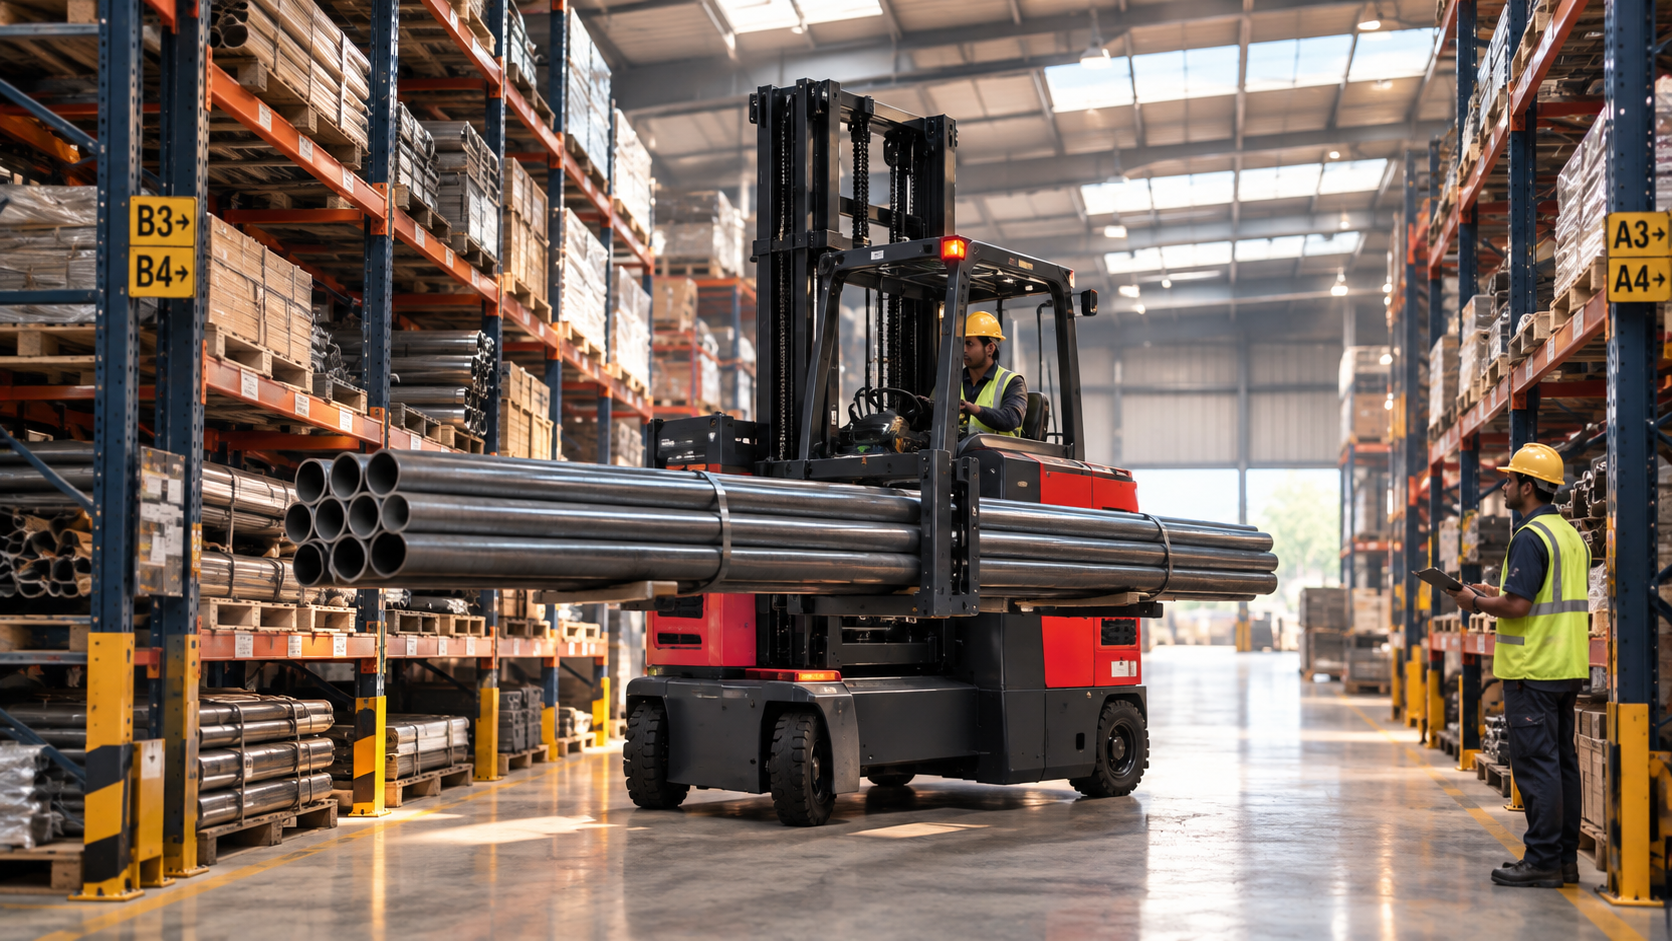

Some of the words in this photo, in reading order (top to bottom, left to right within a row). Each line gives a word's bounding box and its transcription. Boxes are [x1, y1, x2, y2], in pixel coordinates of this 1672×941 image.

[137, 204, 173, 237] B3
[1613, 220, 1649, 249] A3
[136, 254, 173, 288] B4
[1613, 264, 1650, 293] A4
